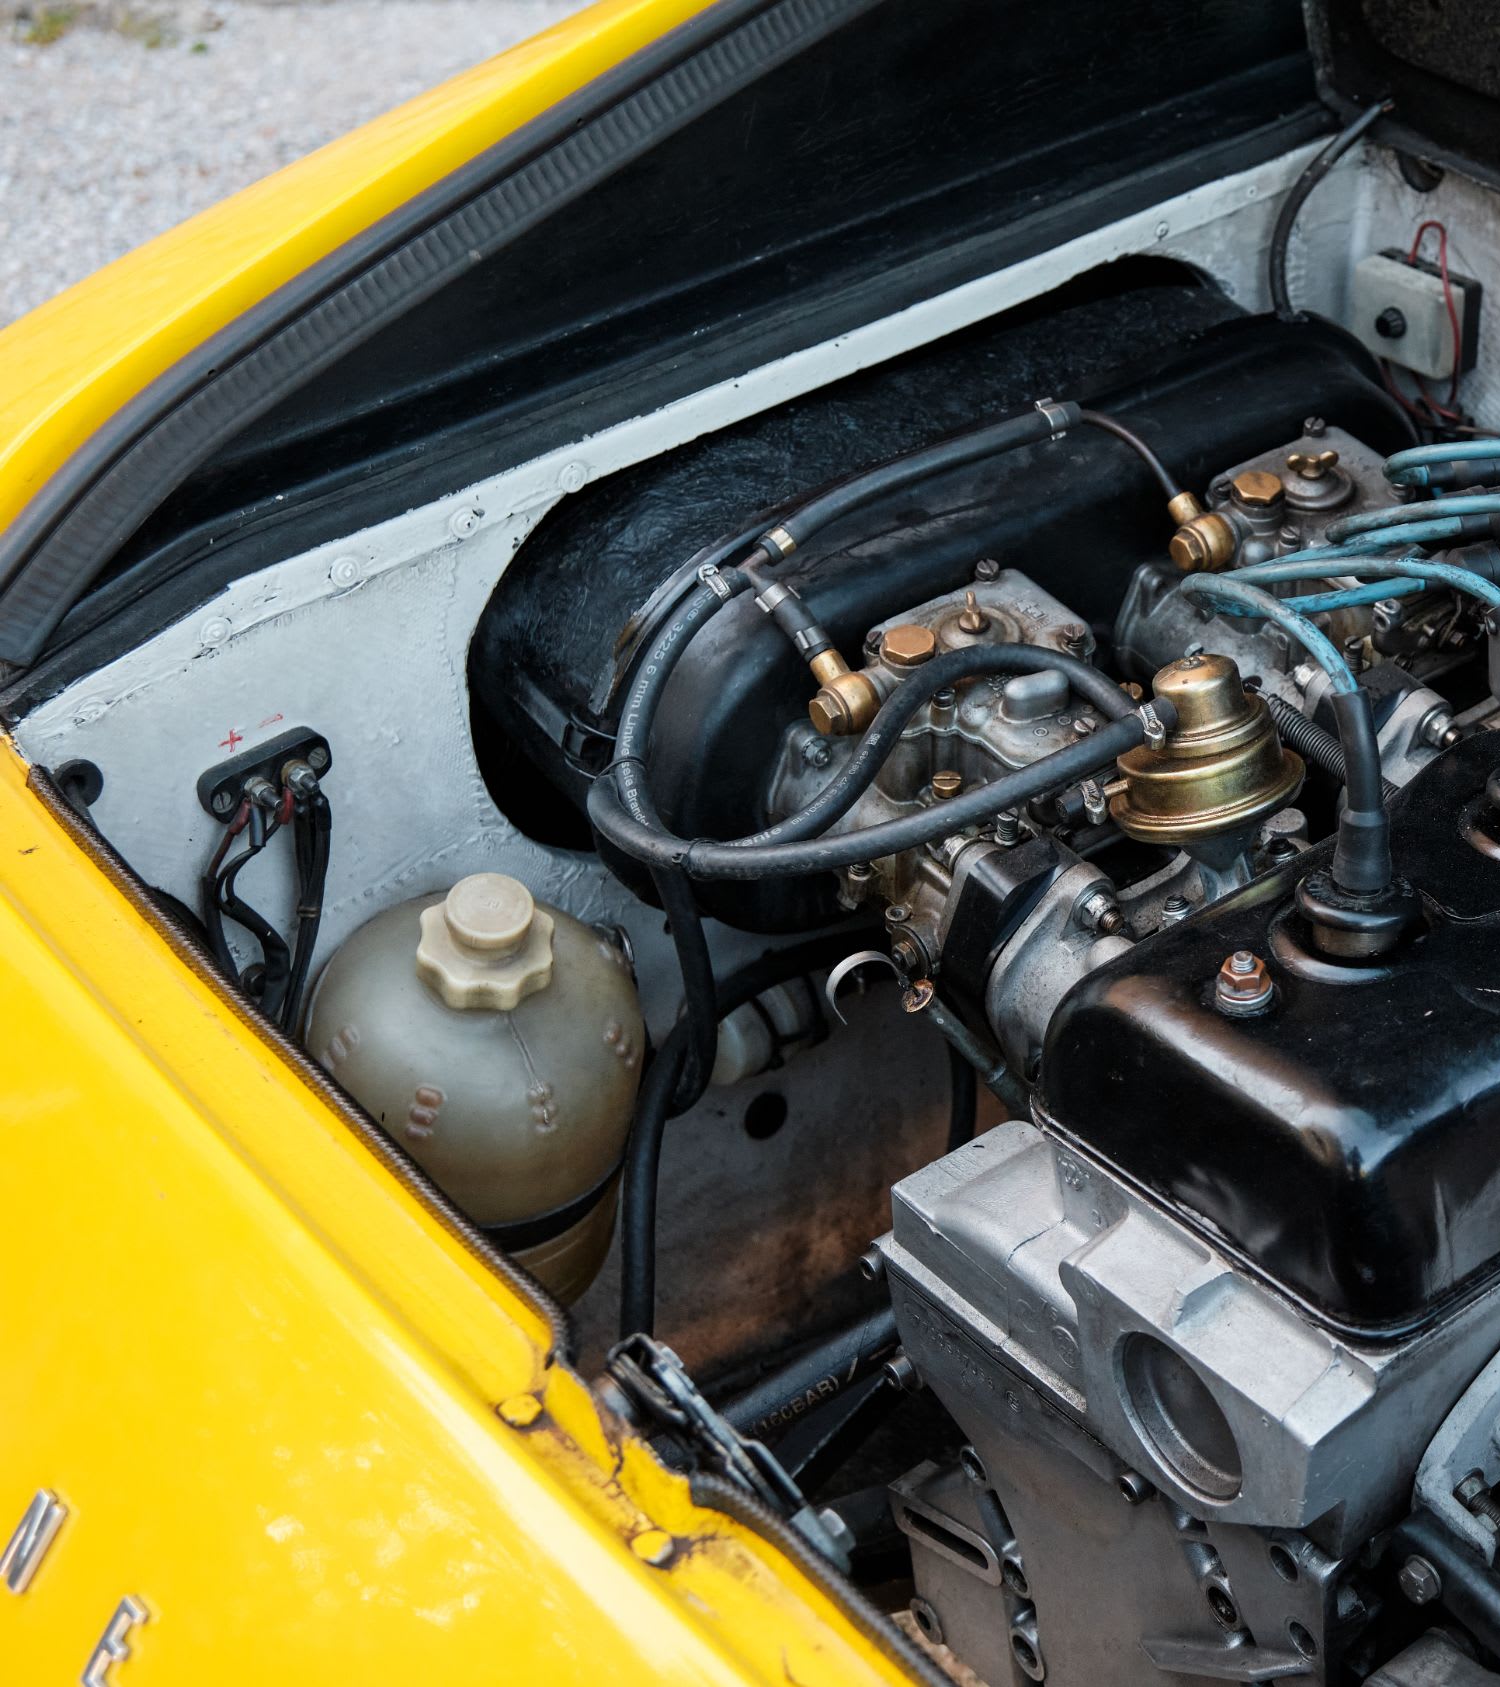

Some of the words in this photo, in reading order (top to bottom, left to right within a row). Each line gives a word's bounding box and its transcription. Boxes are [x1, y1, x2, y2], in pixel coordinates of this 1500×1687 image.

[654, 622, 683, 661] 3225
[647, 665, 657, 675] 6
[632, 680, 649, 708] mm
[621, 713, 639, 787] Univesele
